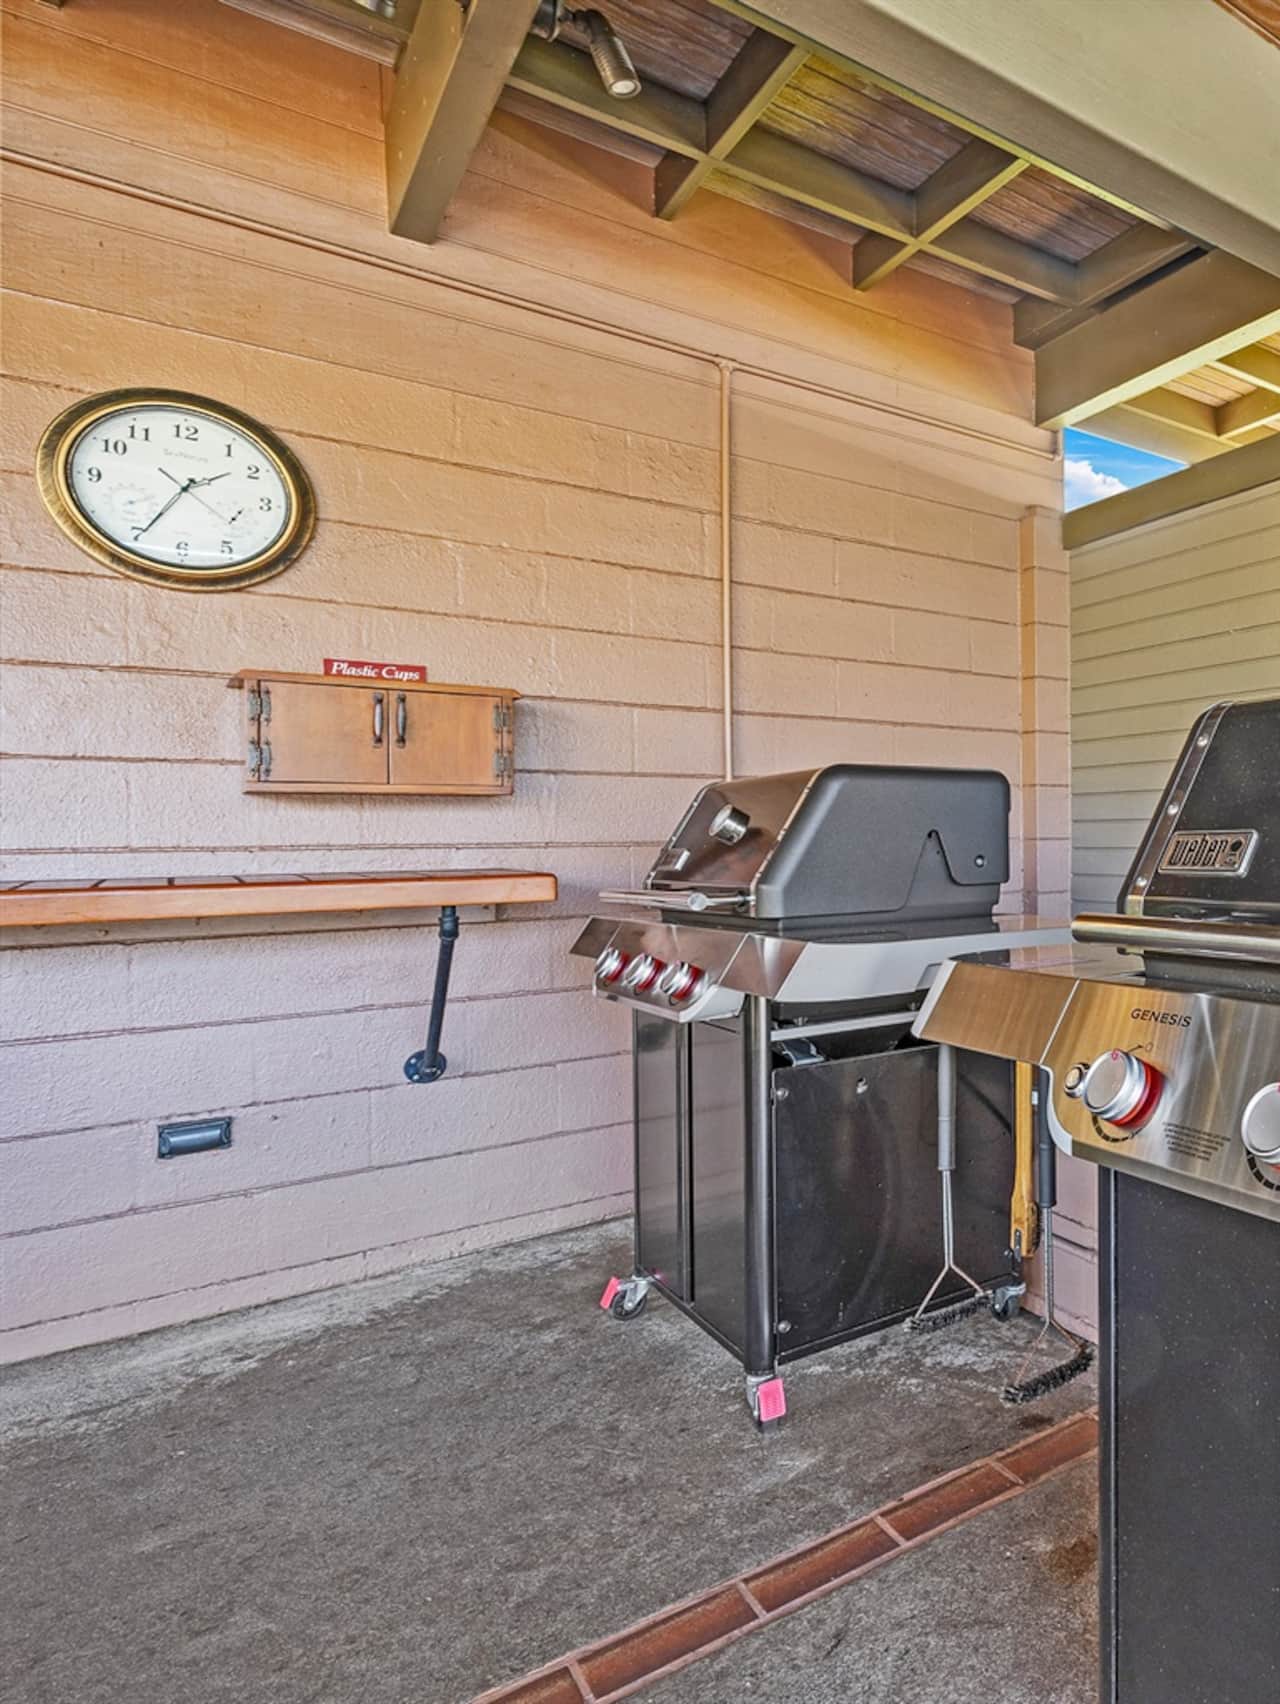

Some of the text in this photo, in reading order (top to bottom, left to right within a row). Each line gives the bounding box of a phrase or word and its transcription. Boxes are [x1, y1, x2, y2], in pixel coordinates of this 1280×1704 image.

[128, 424, 151, 441] 11
[174, 424, 199, 442] 12
[102, 439, 127, 456] 10
[224, 443, 233, 458] 1
[87, 467, 102, 483] 9
[247, 465, 260, 480] 2
[259, 497, 272, 512] 3
[131, 526, 146, 542] 7
[221, 540, 233, 555] 5
[331, 661, 420, 681] Plastic Cups
[1131, 1008, 1192, 1028] GENESIS
